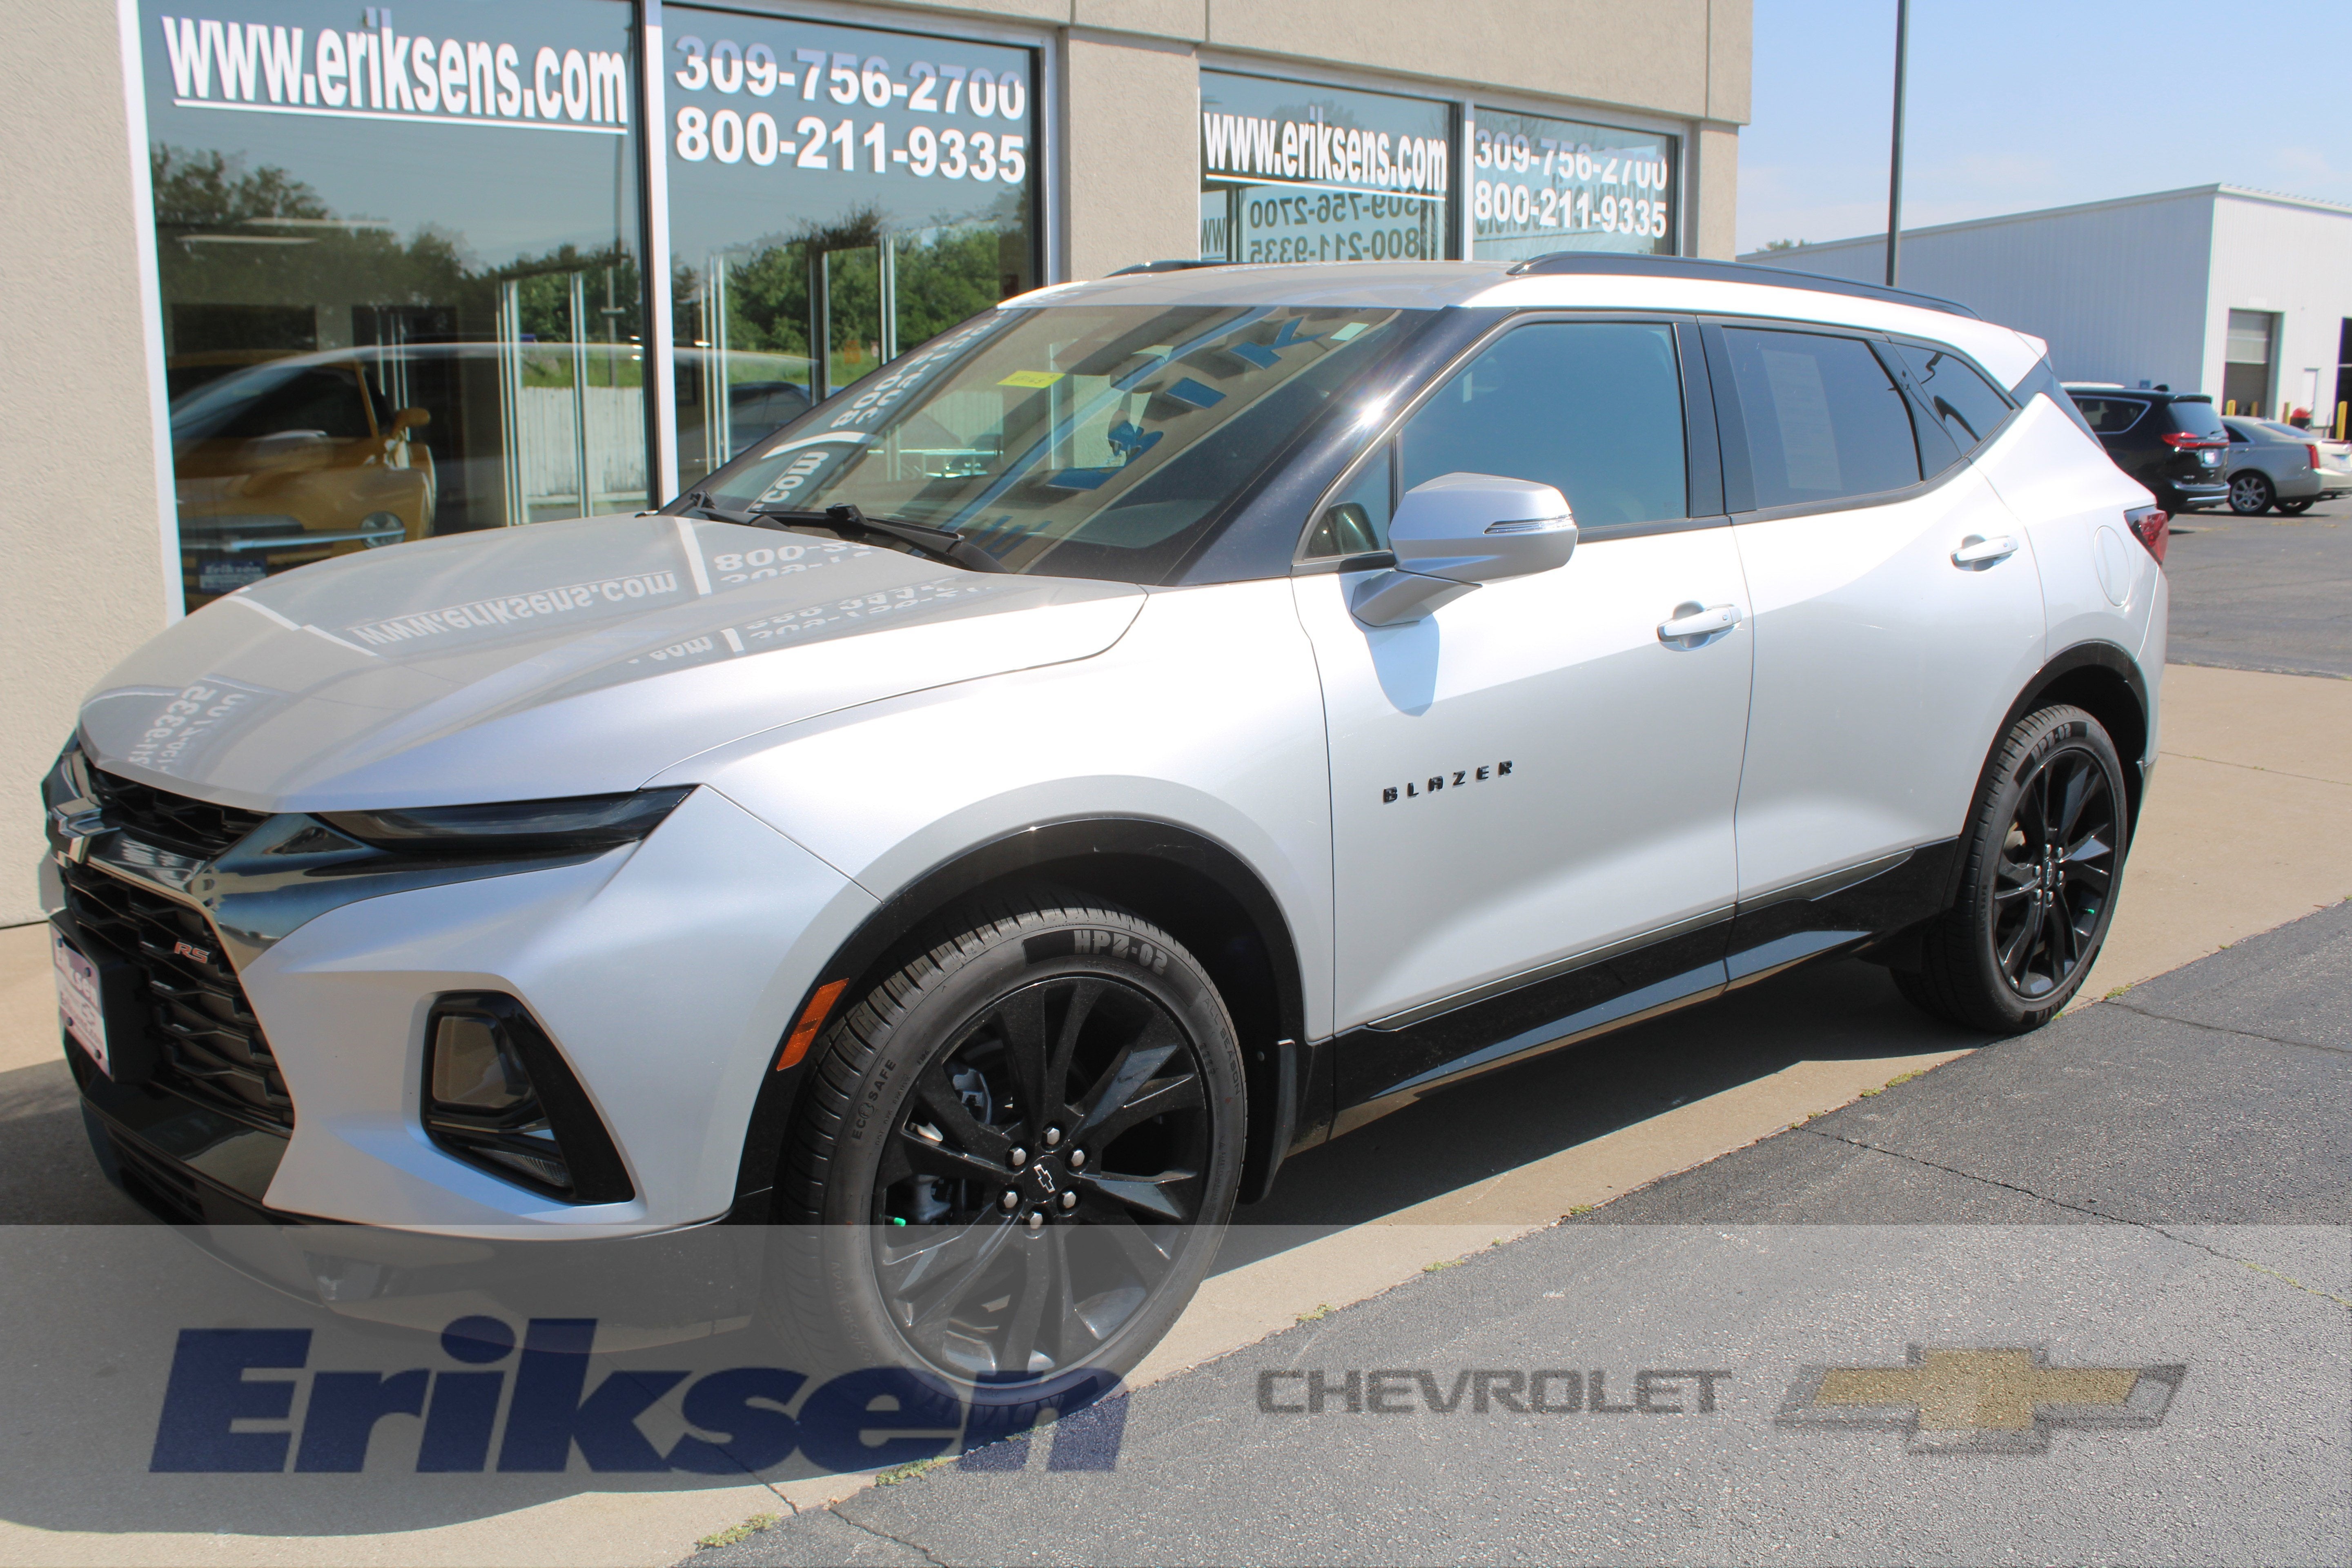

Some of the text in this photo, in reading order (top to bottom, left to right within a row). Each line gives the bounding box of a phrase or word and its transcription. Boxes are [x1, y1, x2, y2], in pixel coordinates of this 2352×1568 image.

[161, 7, 628, 124] www.eriksens.com
[675, 35, 1025, 121] 309-756-2700
[676, 106, 1026, 184] 800-211-9335
[1204, 106, 1447, 191] www.eriksens.com
[1474, 128, 1668, 191] 309-756-2700
[1474, 180, 1667, 238] 800-211-9335
[1383, 760, 1512, 804] BLAZER
[174, 941, 210, 964] RS
[1202, 998, 1219, 1026] ALL
[1219, 1027, 1241, 1096] SEASON
